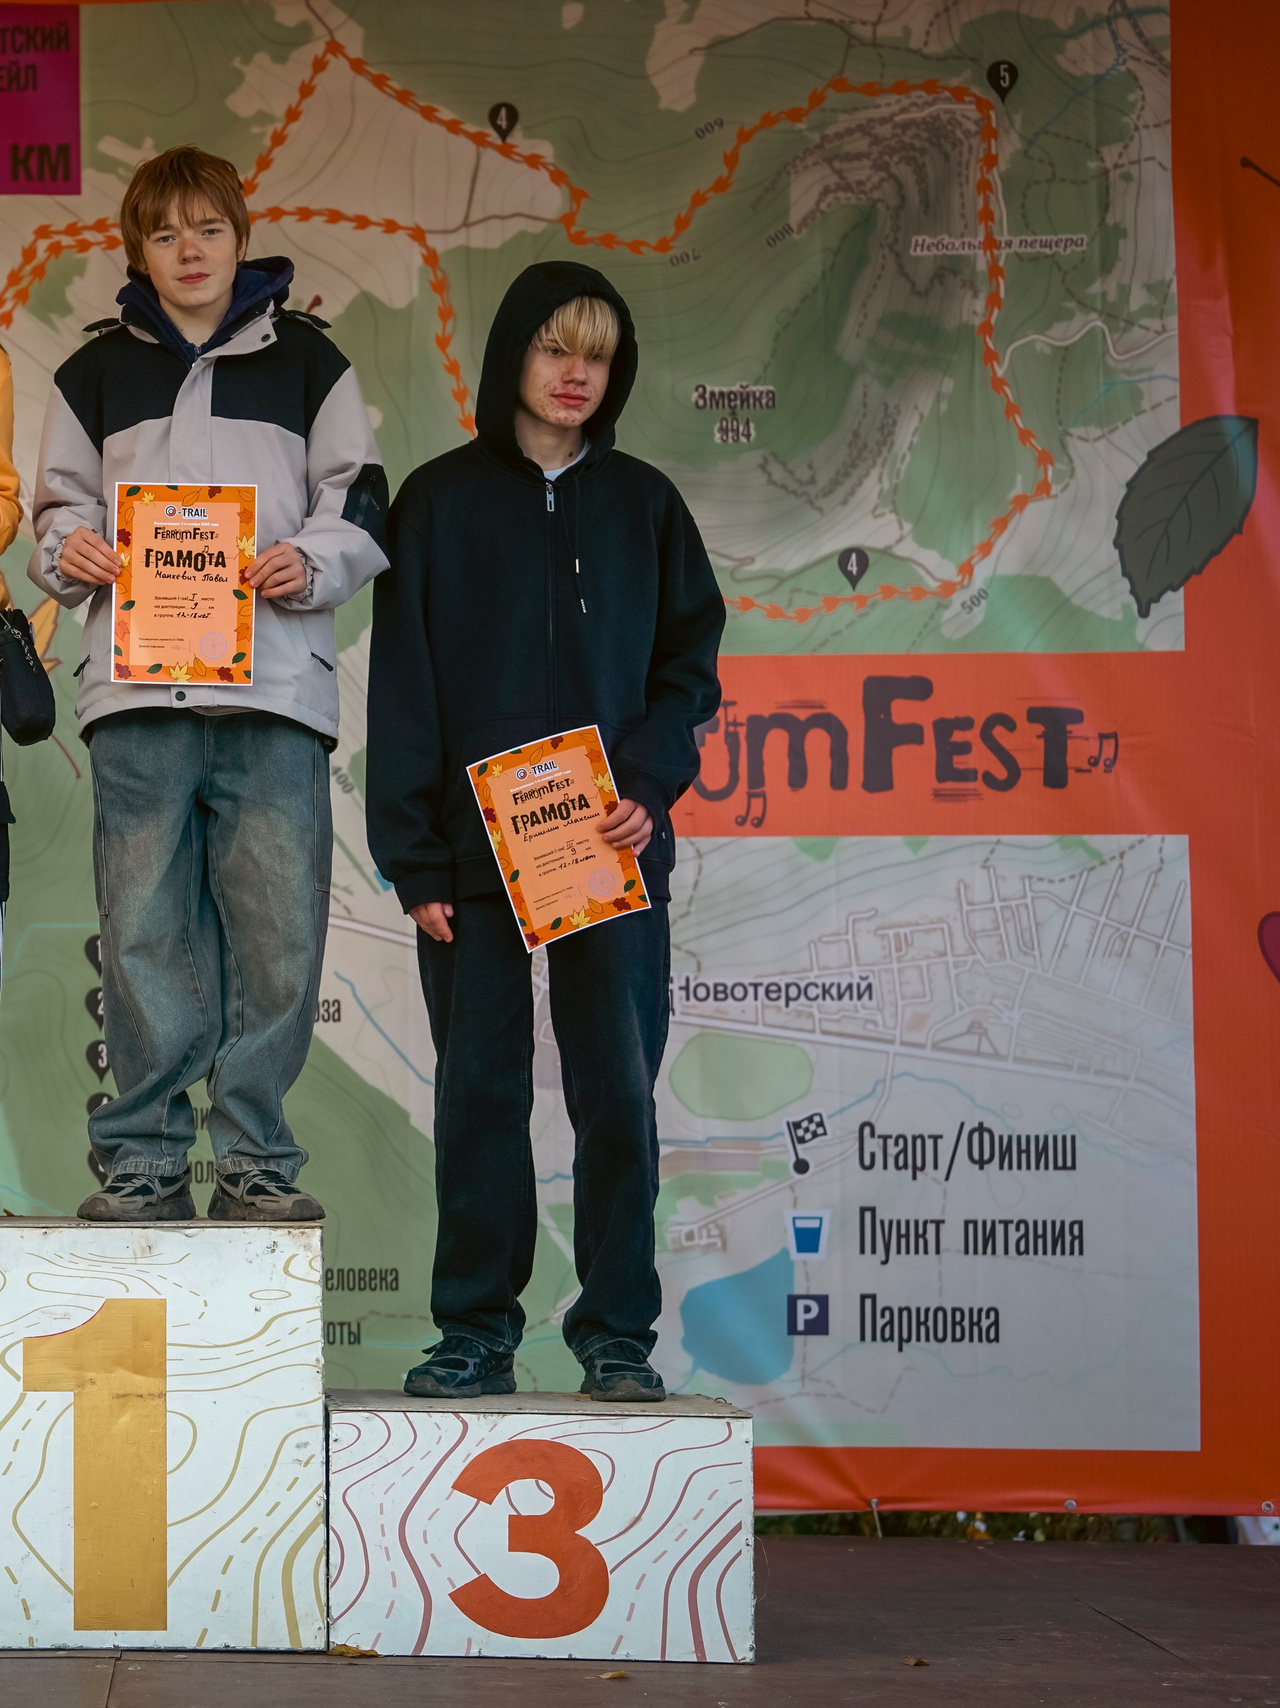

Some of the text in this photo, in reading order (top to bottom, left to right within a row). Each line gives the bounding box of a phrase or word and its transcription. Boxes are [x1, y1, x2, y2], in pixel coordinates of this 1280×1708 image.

[1000, 65, 1010, 89] 5
[497, 107, 508, 132] 4
[11, 144, 71, 183] КМ
[913, 236, 1084, 253] Неболья пещера
[694, 384, 776, 410] Змейка
[144, 548, 227, 572] ГРАМОТА
[847, 553, 858, 576] 4
[190, 602, 199, 610] 9
[961, 587, 990, 615] 500
[511, 793, 591, 835] ГРАМОТА
[570, 847, 577, 856] 9
[98, 1043, 108, 1068] 3
[857, 1121, 1078, 1181] Старт/Финиш
[858, 1207, 1085, 1265] Пункт питания
[325, 1267, 399, 1291] еловека
[323, 1321, 361, 1345] оты
[859, 1294, 1001, 1352] Парковка
[23, 1298, 167, 1631] 1
[448, 1438, 611, 1639] 3
